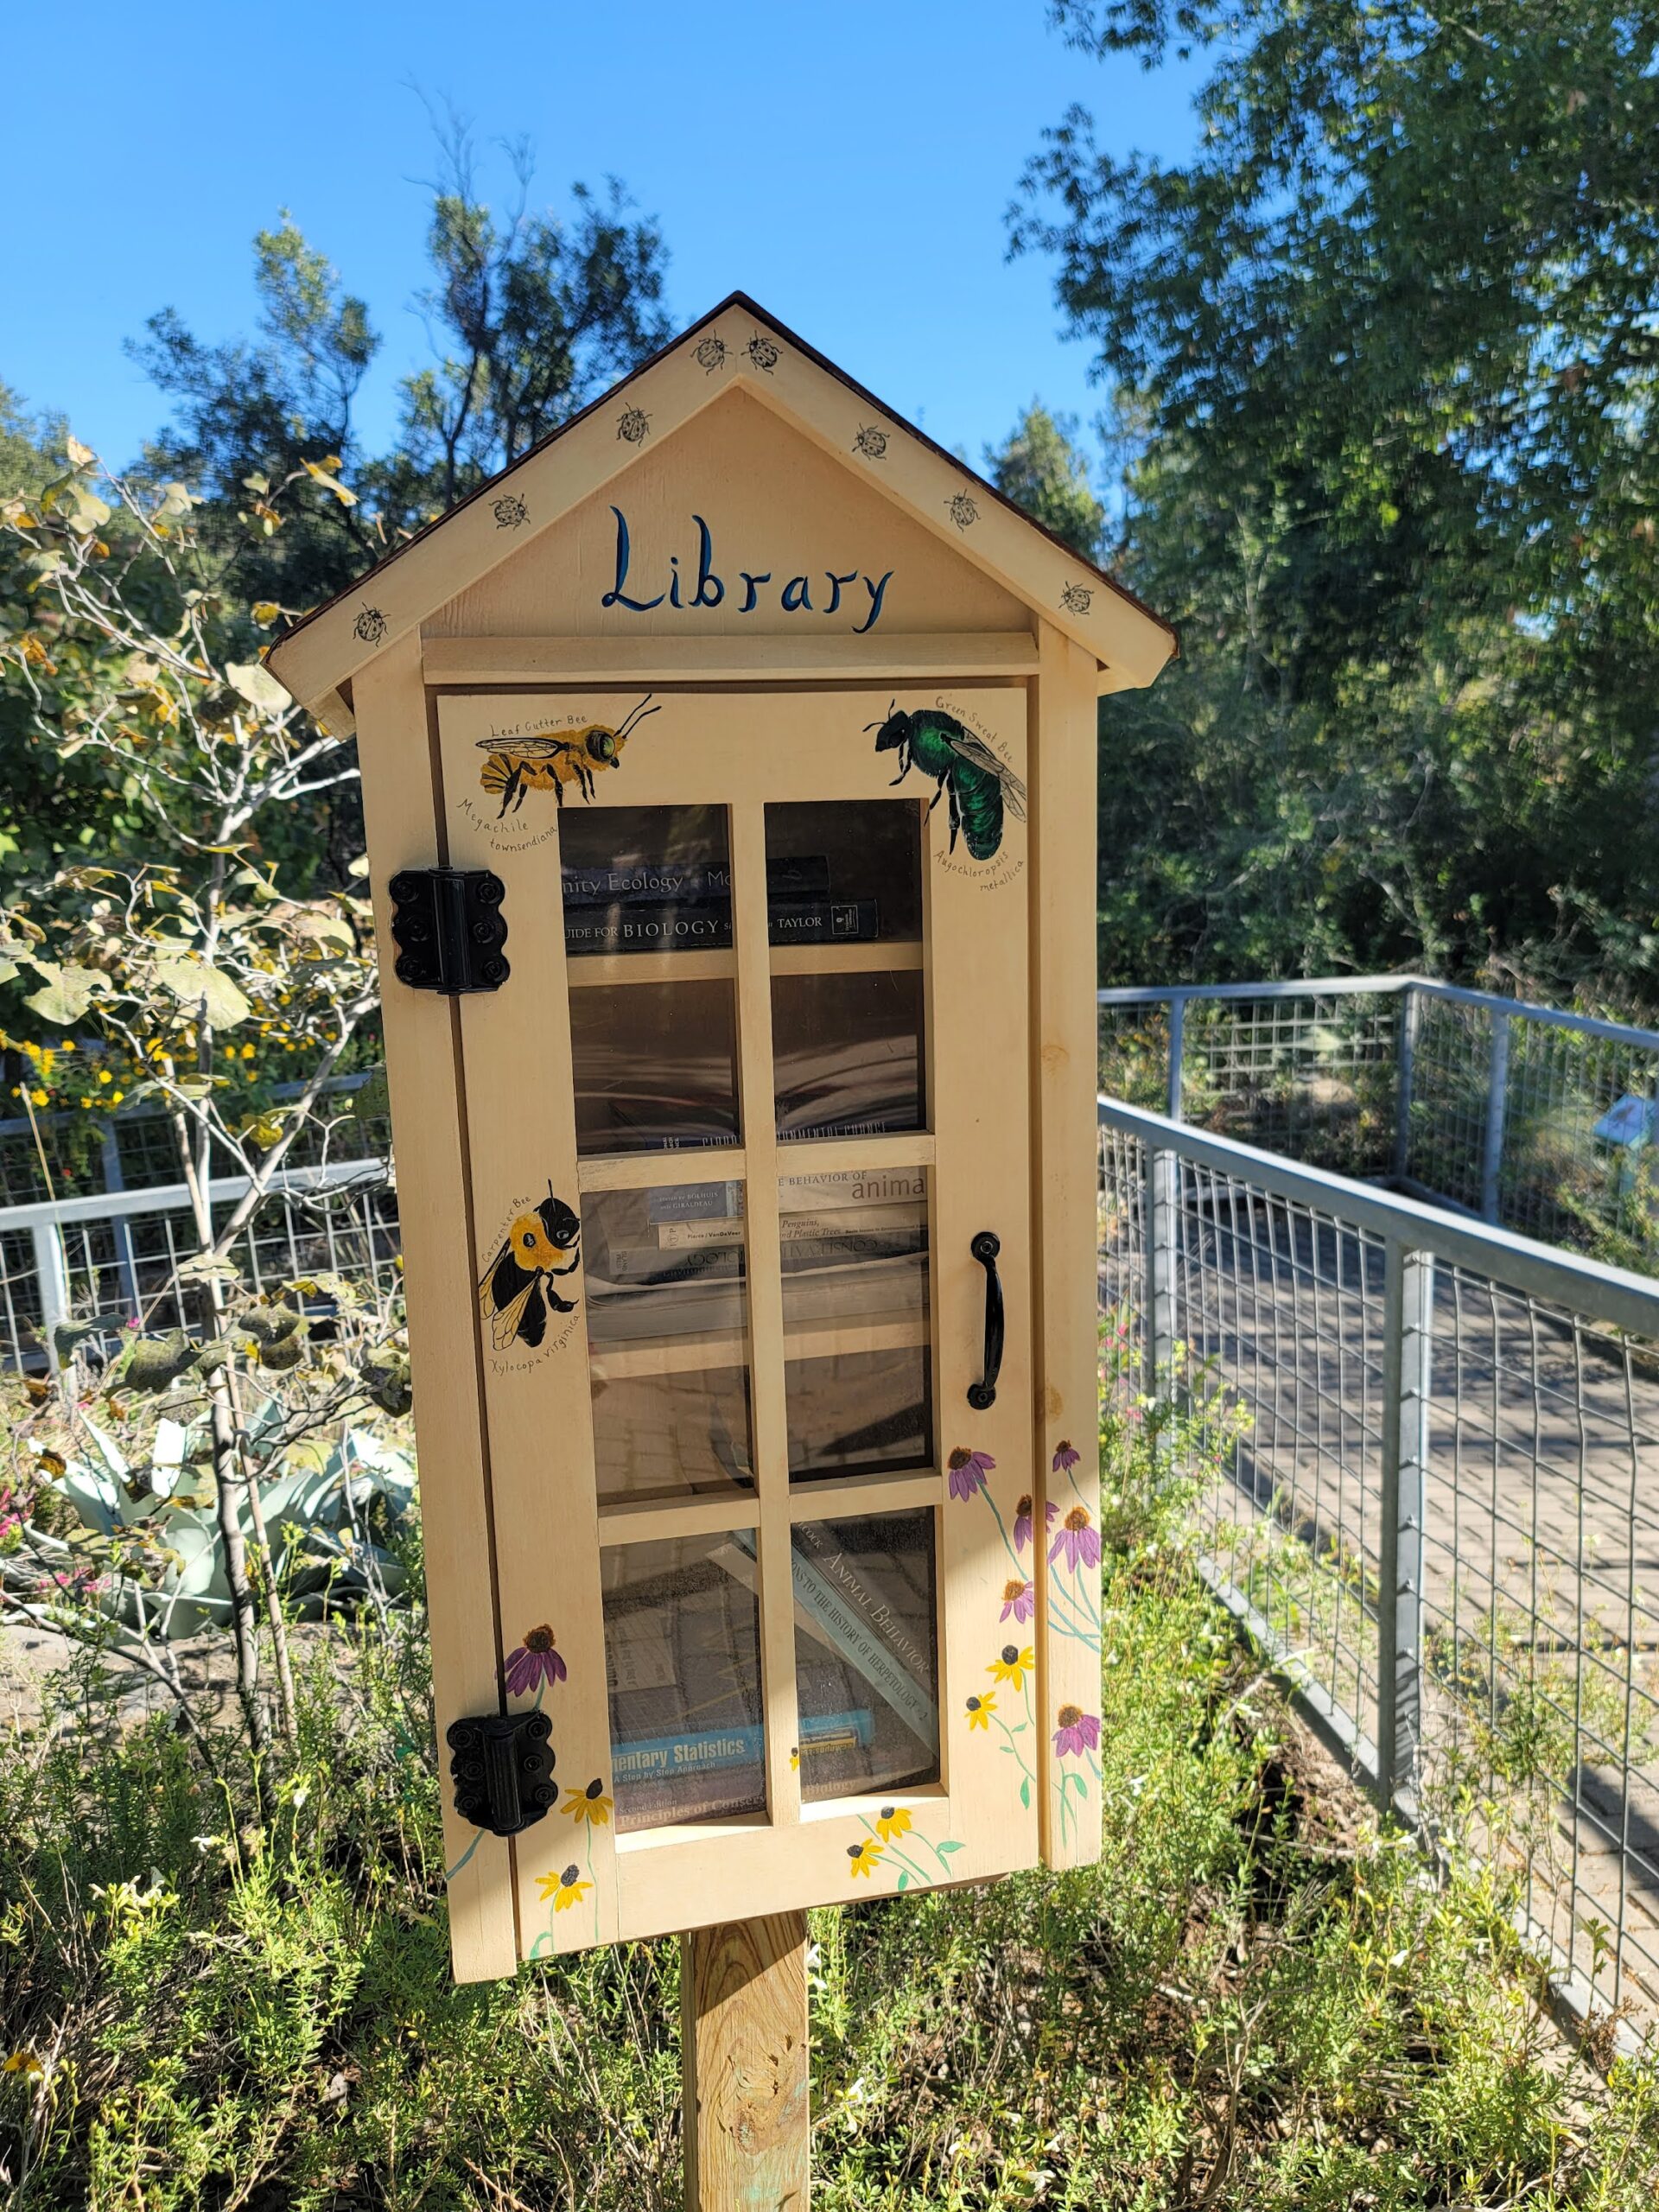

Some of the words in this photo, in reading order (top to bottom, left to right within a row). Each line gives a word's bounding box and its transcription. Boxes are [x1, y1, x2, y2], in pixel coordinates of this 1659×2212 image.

[601, 505, 894, 633] Library
[490, 724, 520, 738] Leaf
[524, 718, 563, 731] Cutter
[567, 715, 588, 725] Bee
[935, 696, 966, 717] Green
[968, 712, 997, 742] Sweat
[997, 742, 1013, 763] Bee
[456, 798, 529, 834] Megachile
[490, 825, 557, 852] townsendiana
[933, 850, 1008, 879] Augochloropsis
[980, 860, 1024, 892] metallica
[607, 872, 683, 893] Ecology
[594, 926, 619, 938] FOR
[624, 920, 718, 938] BIOLOGY
[777, 917, 823, 928] TAYLOR
[789, 1173, 849, 1185] BEHAVIOR
[852, 1171, 867, 1181] OF
[481, 1209, 514, 1263] Carpenter
[512, 1196, 532, 1210] Bee
[782, 1219, 819, 1229] Penguins,
[793, 1228, 821, 1238] Plastic
[488, 1357, 543, 1376] Xylocopa
[543, 1315, 580, 1358] virginica
[813, 1590, 833, 1613] THE
[828, 1607, 863, 1644] HISTORY
[857, 1641, 873, 1656] OF
[868, 1652, 919, 1710] HERPETOLOGY
[674, 1738, 746, 1764] Statistics
[622, 1774, 641, 1783] Step
[645, 1770, 655, 1780] by
[656, 1768, 675, 1777] Step
[677, 1762, 715, 1775] Approach
[620, 1804, 691, 1827] Principles
[694, 1801, 708, 1815] of
